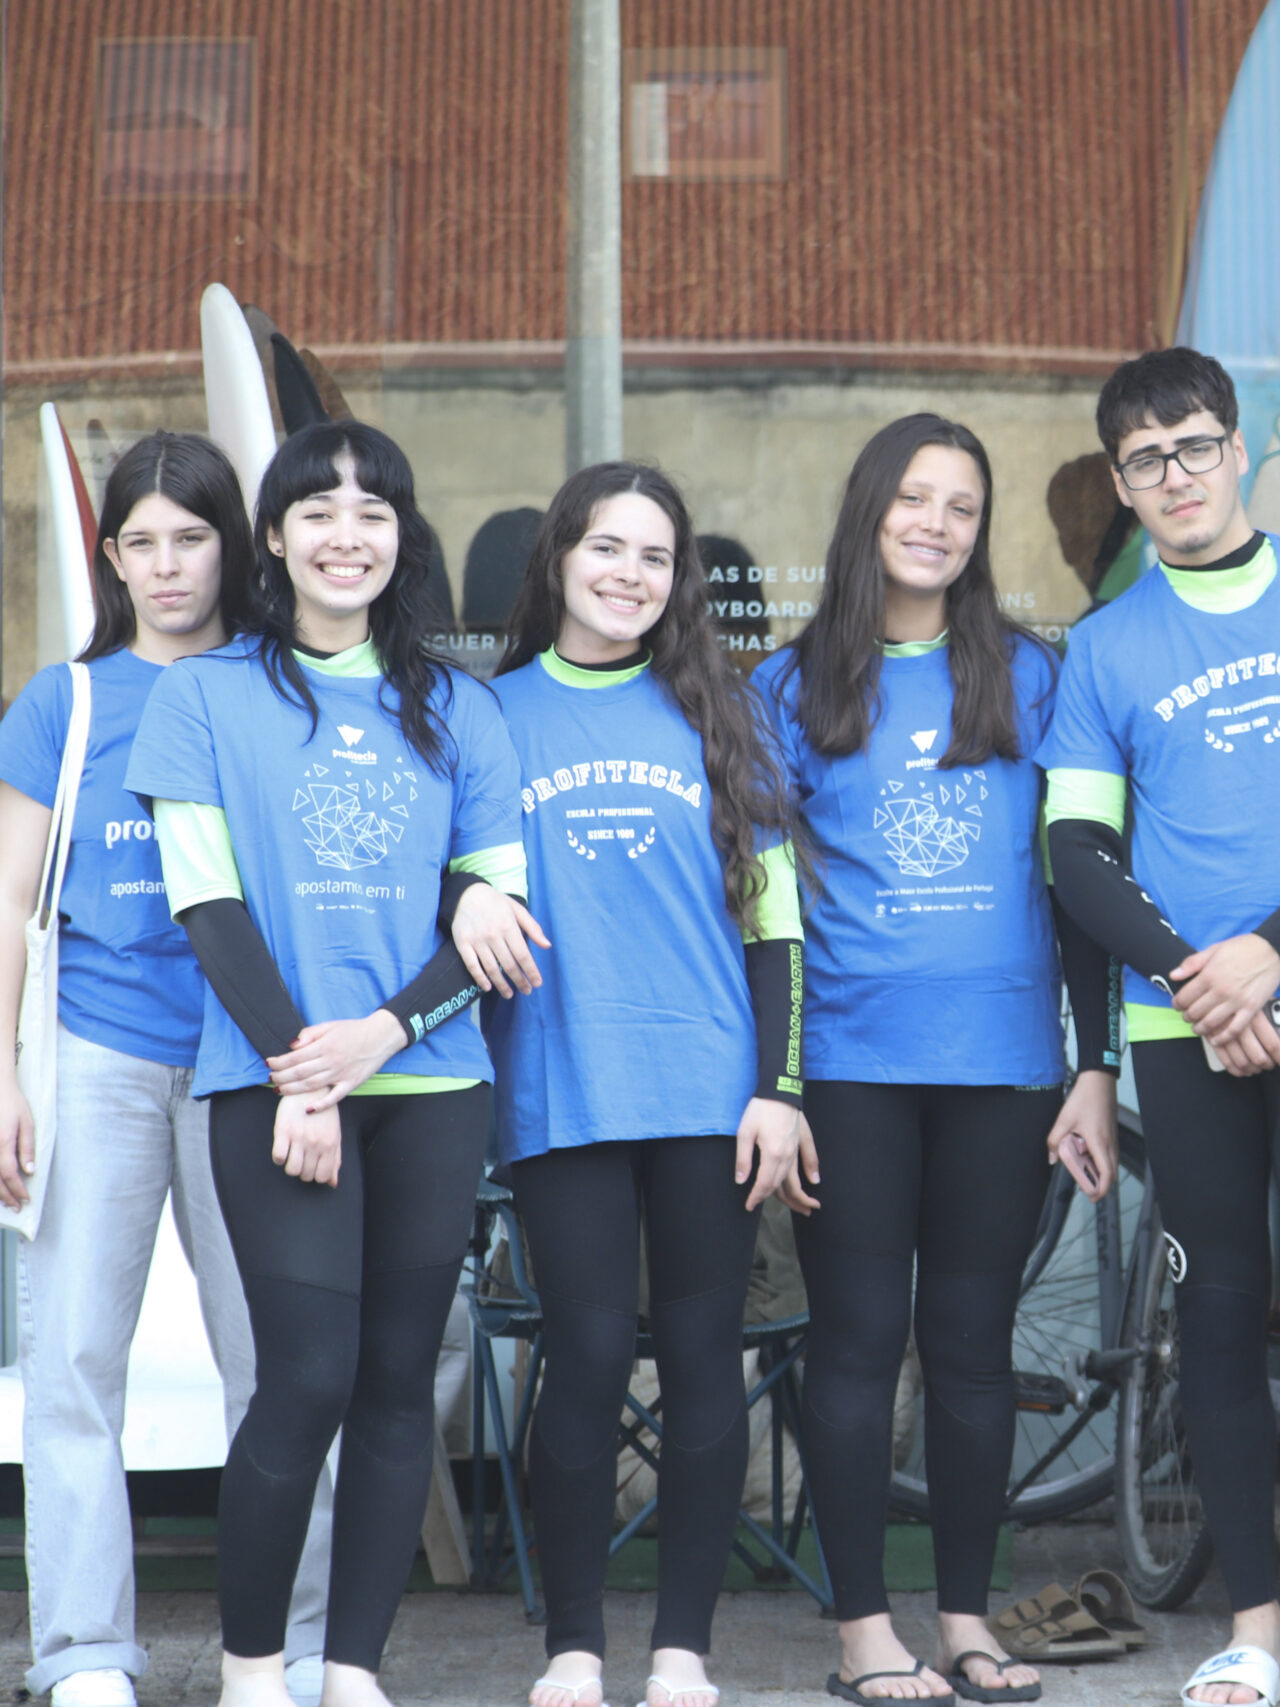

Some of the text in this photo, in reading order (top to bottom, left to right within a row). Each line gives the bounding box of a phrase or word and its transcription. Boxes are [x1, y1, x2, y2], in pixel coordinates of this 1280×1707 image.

[704, 565, 740, 583] AS
[747, 565, 778, 583] DE
[521, 760, 702, 814] PROFITECLA
[587, 830, 615, 840] SINCE
[365, 886, 390, 899] em
[396, 885, 405, 900] ti
